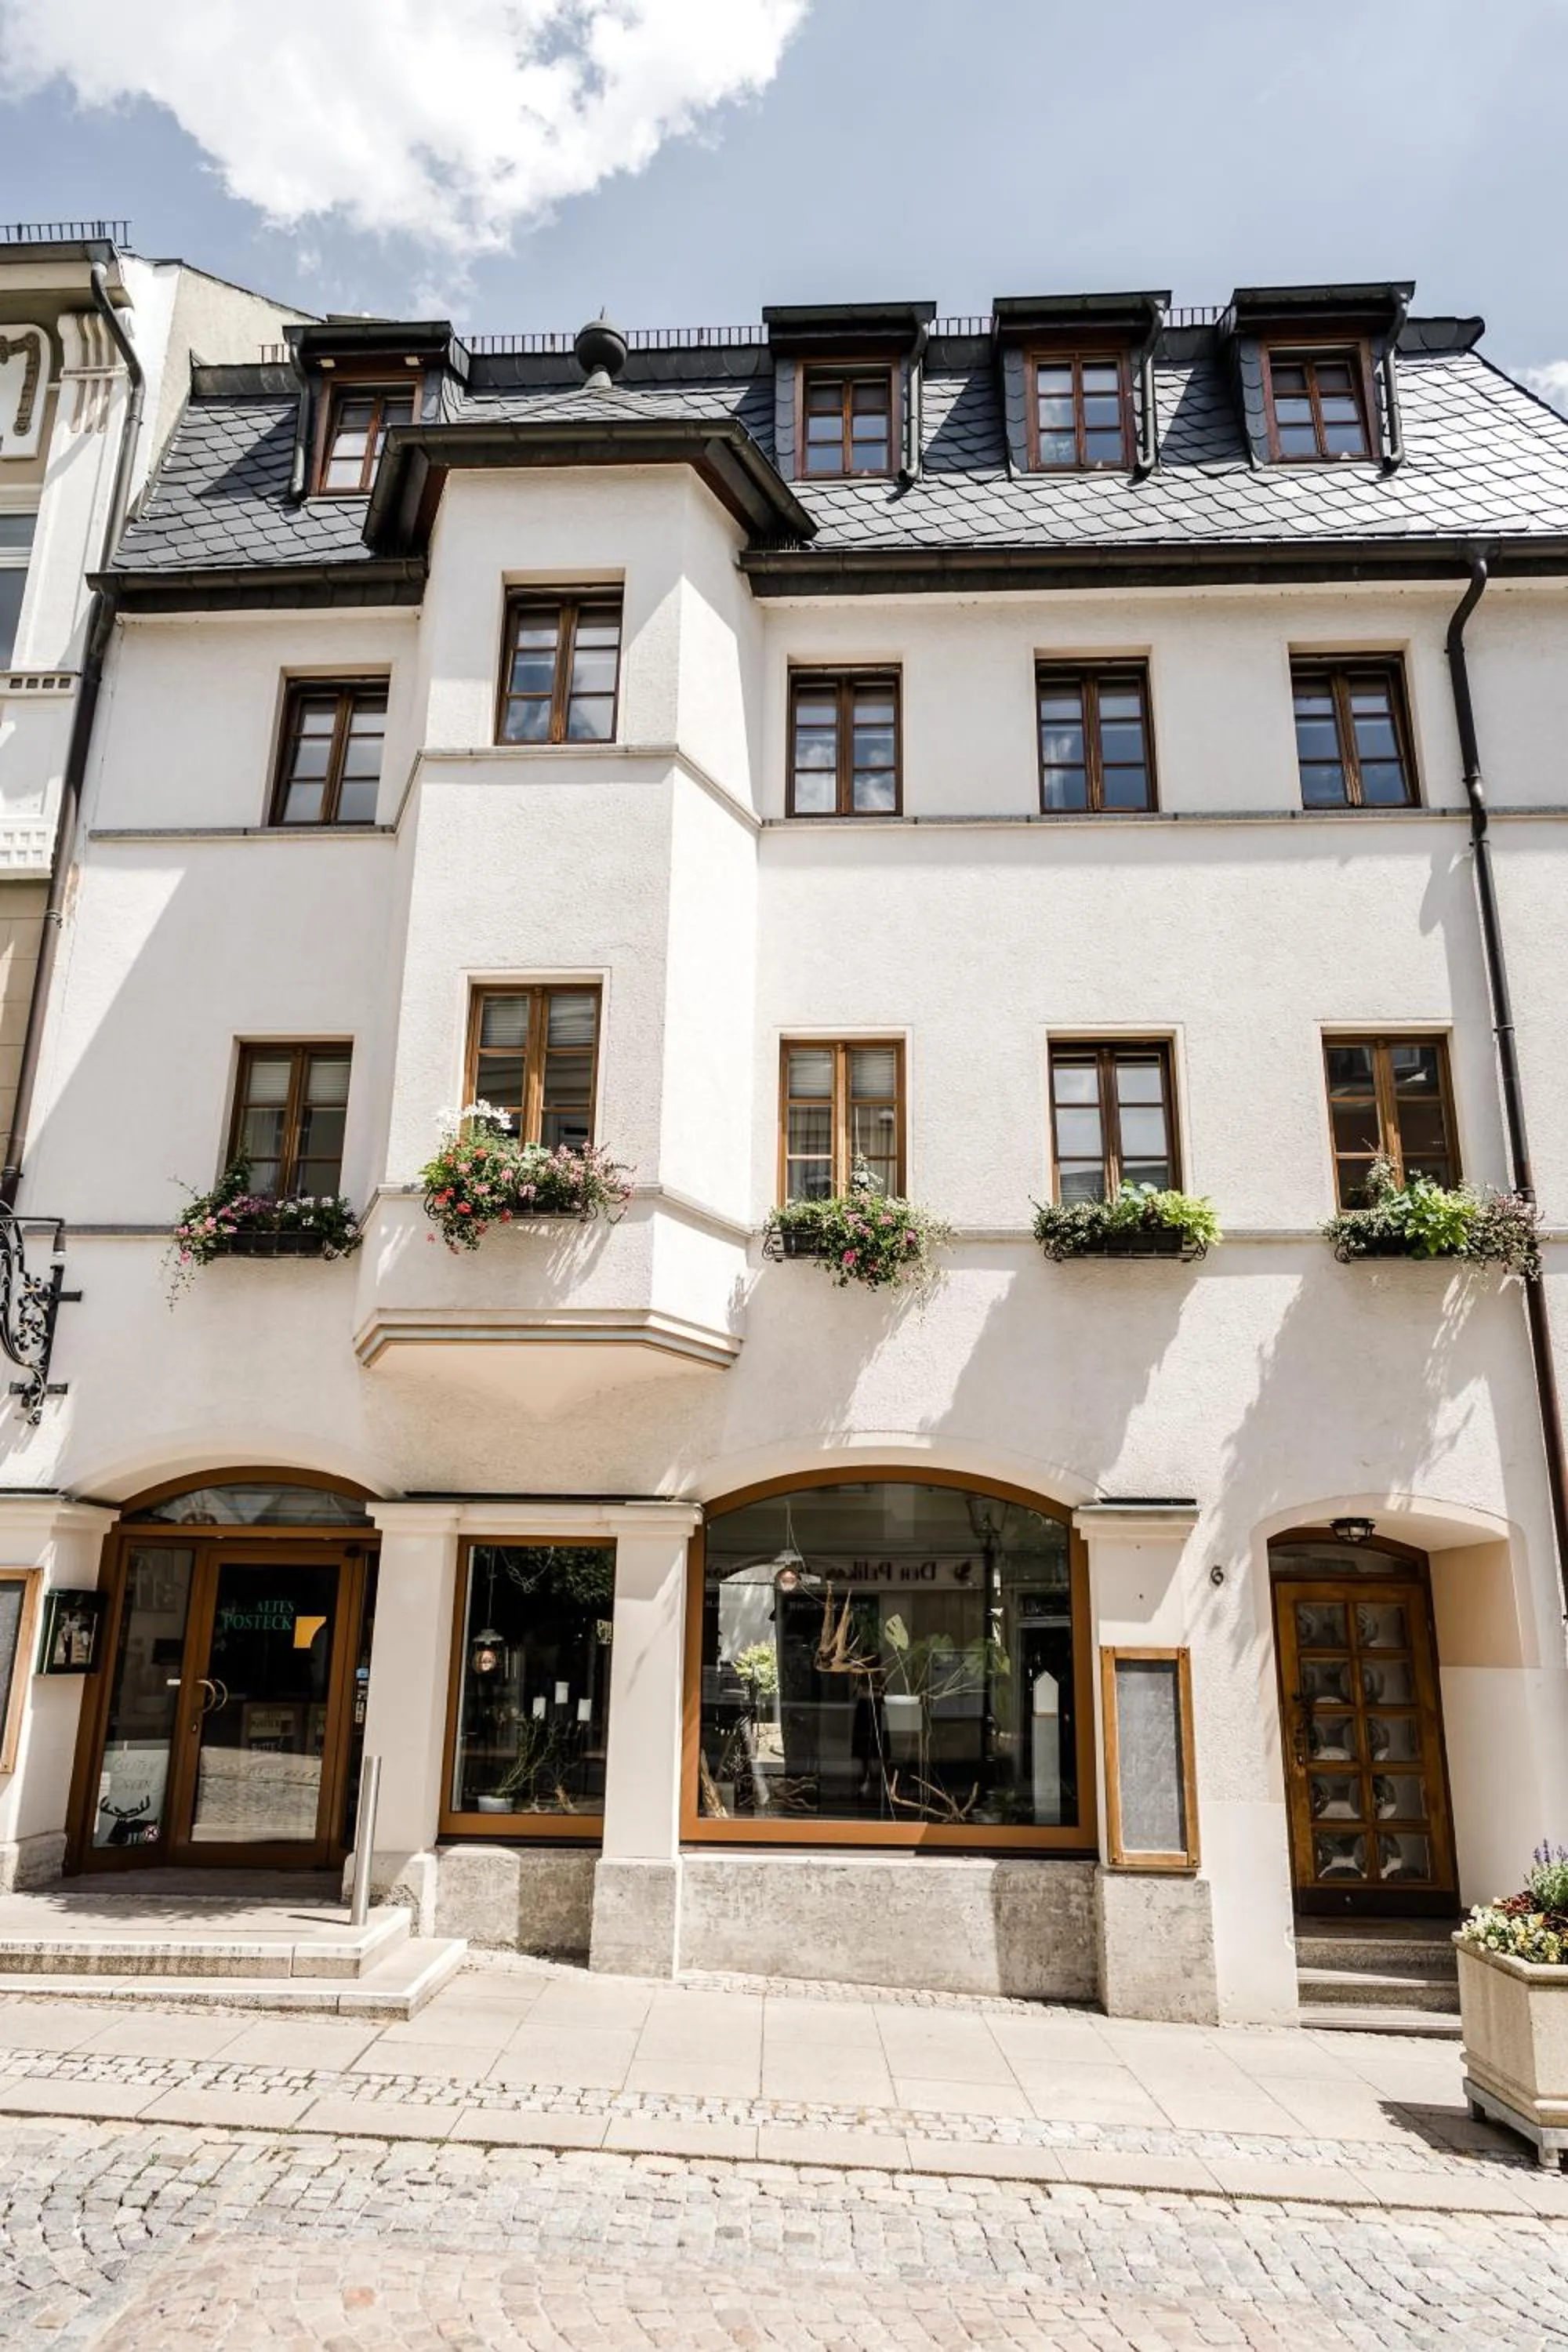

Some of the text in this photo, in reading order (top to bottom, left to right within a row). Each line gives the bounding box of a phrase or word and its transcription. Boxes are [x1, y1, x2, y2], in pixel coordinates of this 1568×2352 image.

[1210, 1565, 1224, 1586] 6
[256, 1600, 295, 1613] ALTES
[223, 1613, 292, 1630] POSTECK
